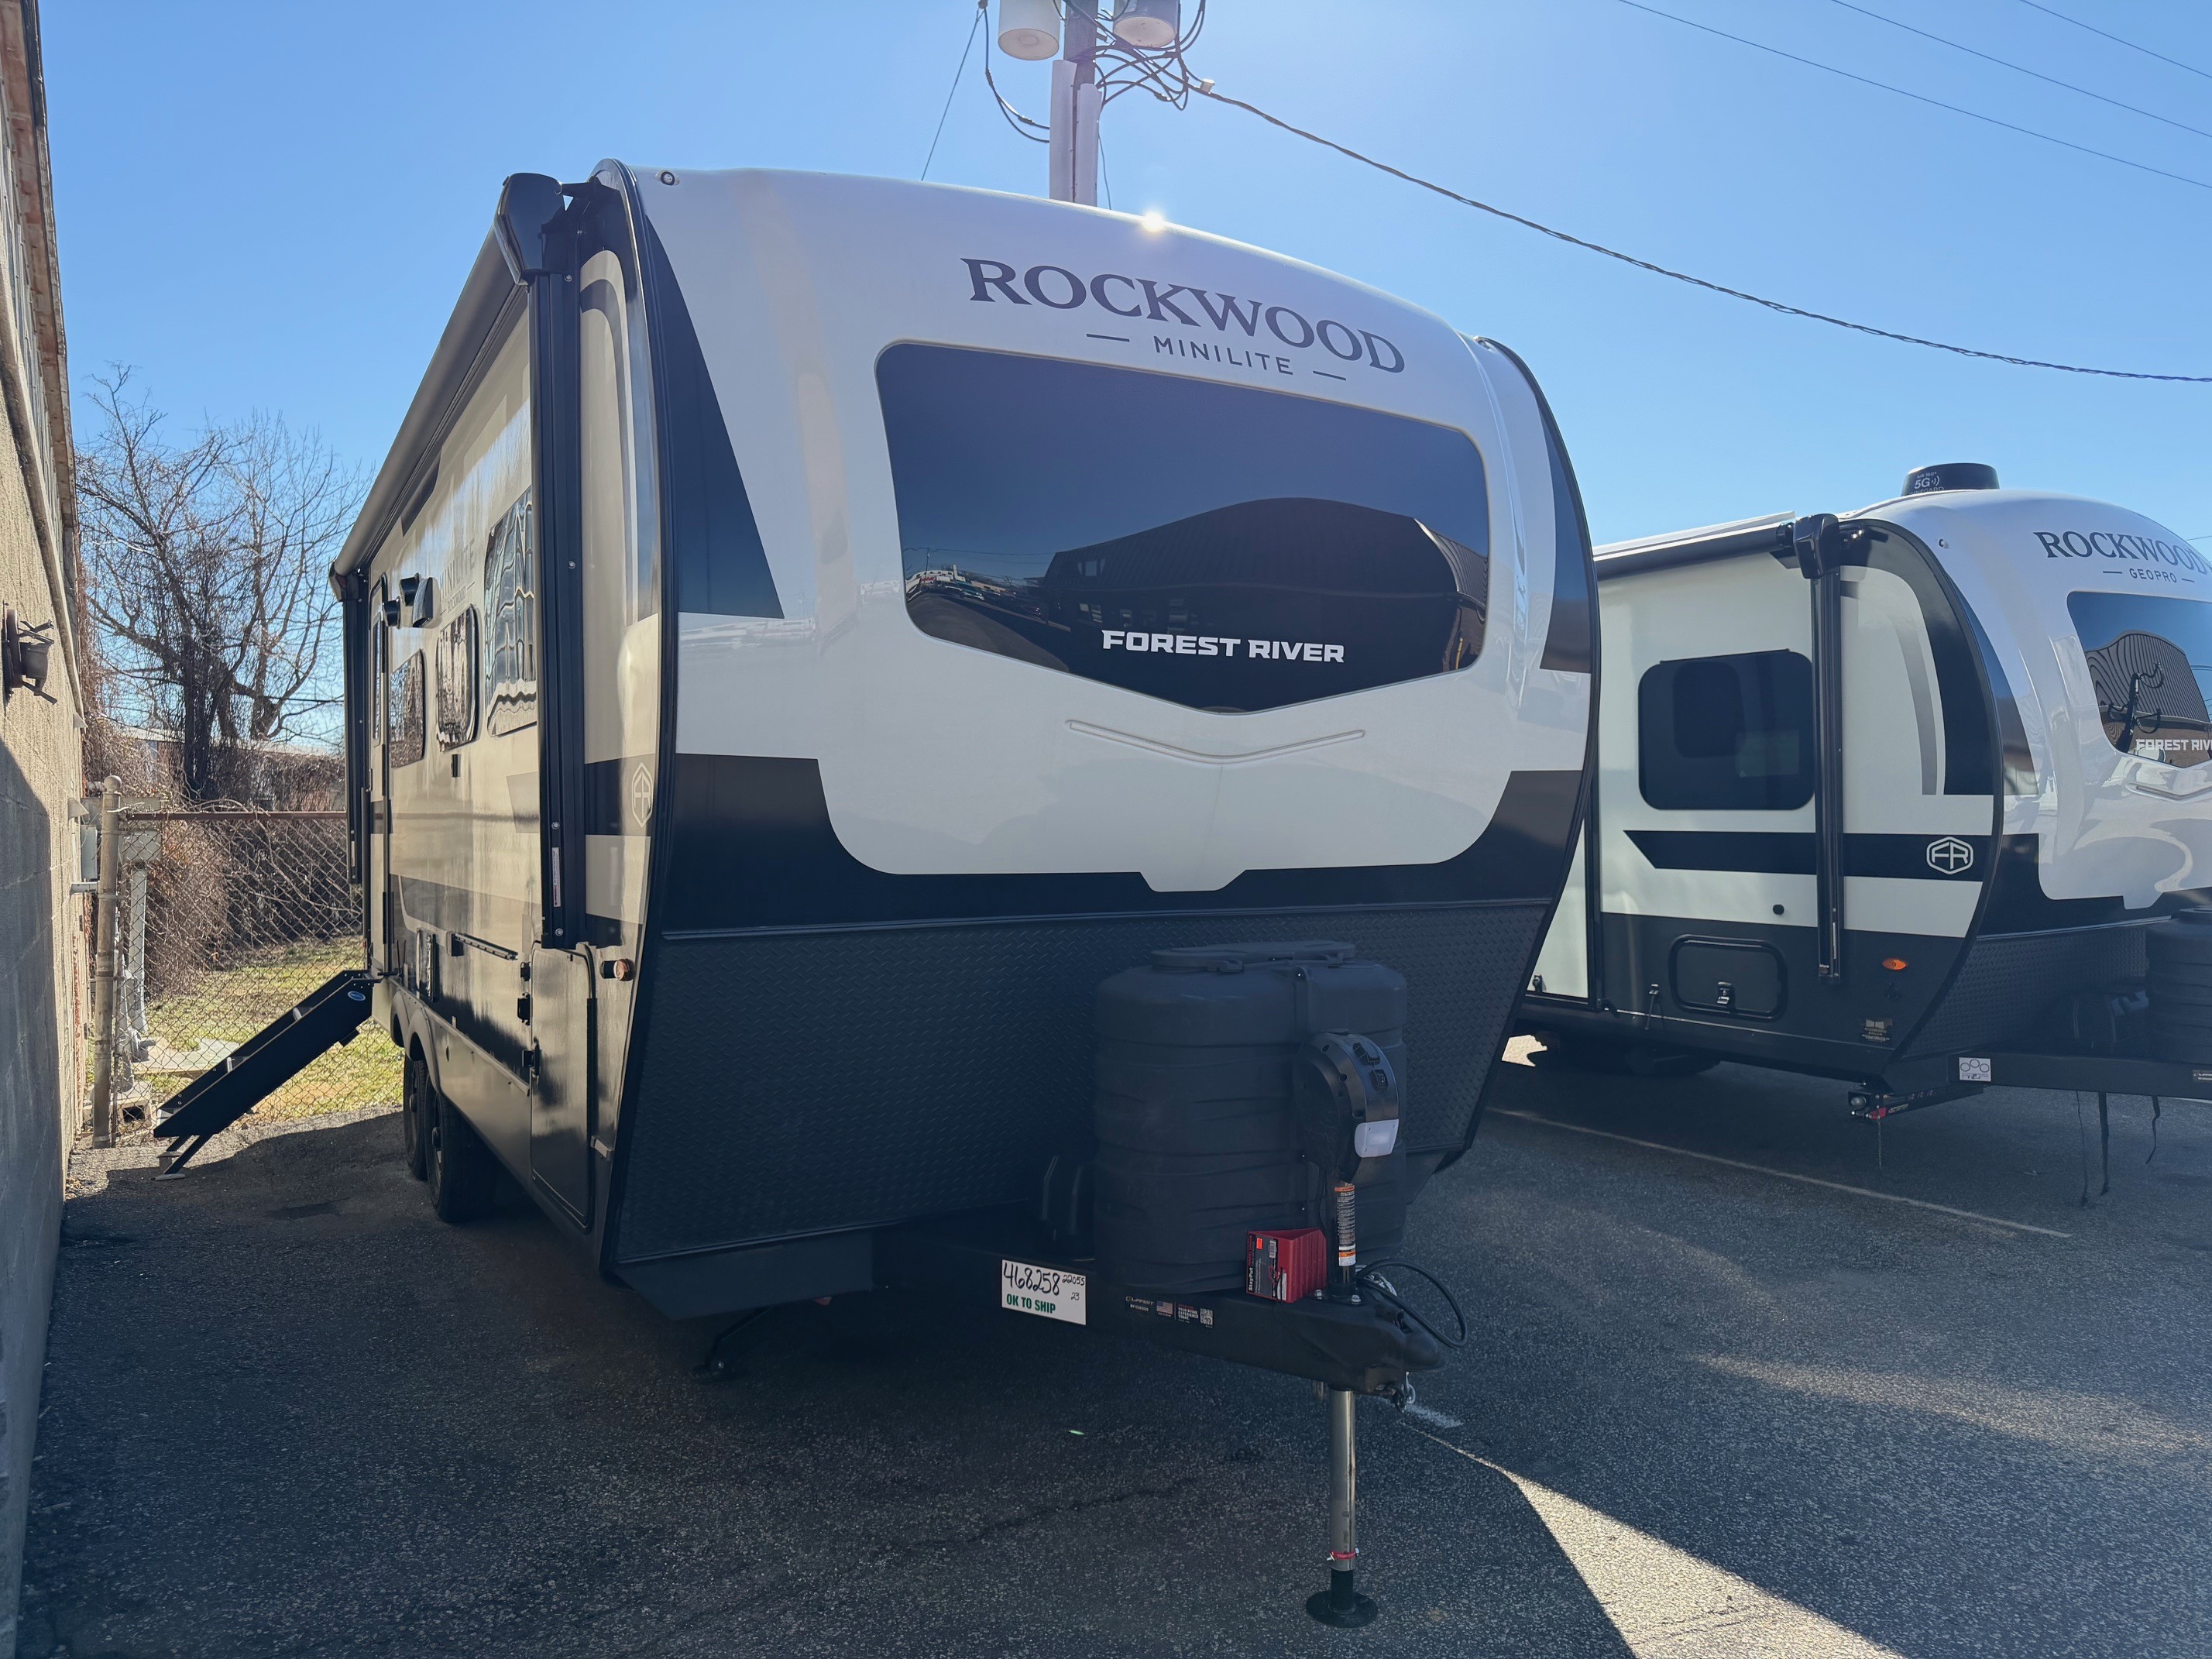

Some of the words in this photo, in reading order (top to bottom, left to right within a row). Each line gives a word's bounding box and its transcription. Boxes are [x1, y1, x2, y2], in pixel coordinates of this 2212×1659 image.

[960, 258, 1405, 374] ROCKWOOD
[1155, 336, 1293, 375] MINILITE
[1915, 477, 1930, 489] 5G
[2033, 531, 2207, 575] ROCKWOOD
[440, 538, 475, 603] MINILITE
[2129, 568, 2177, 583] GEOPRO
[1101, 630, 1241, 657] FOREST
[1248, 639, 1345, 664] RIVER
[2135, 739, 2189, 751] FOREST
[2191, 739, 2212, 751] RIV
[1003, 1262, 1060, 1296] 468258
[1070, 1292, 1080, 1300] 23
[1006, 1293, 1018, 1307] OK
[1021, 1297, 1032, 1309] TO
[1035, 1300, 1056, 1314] SHIP
